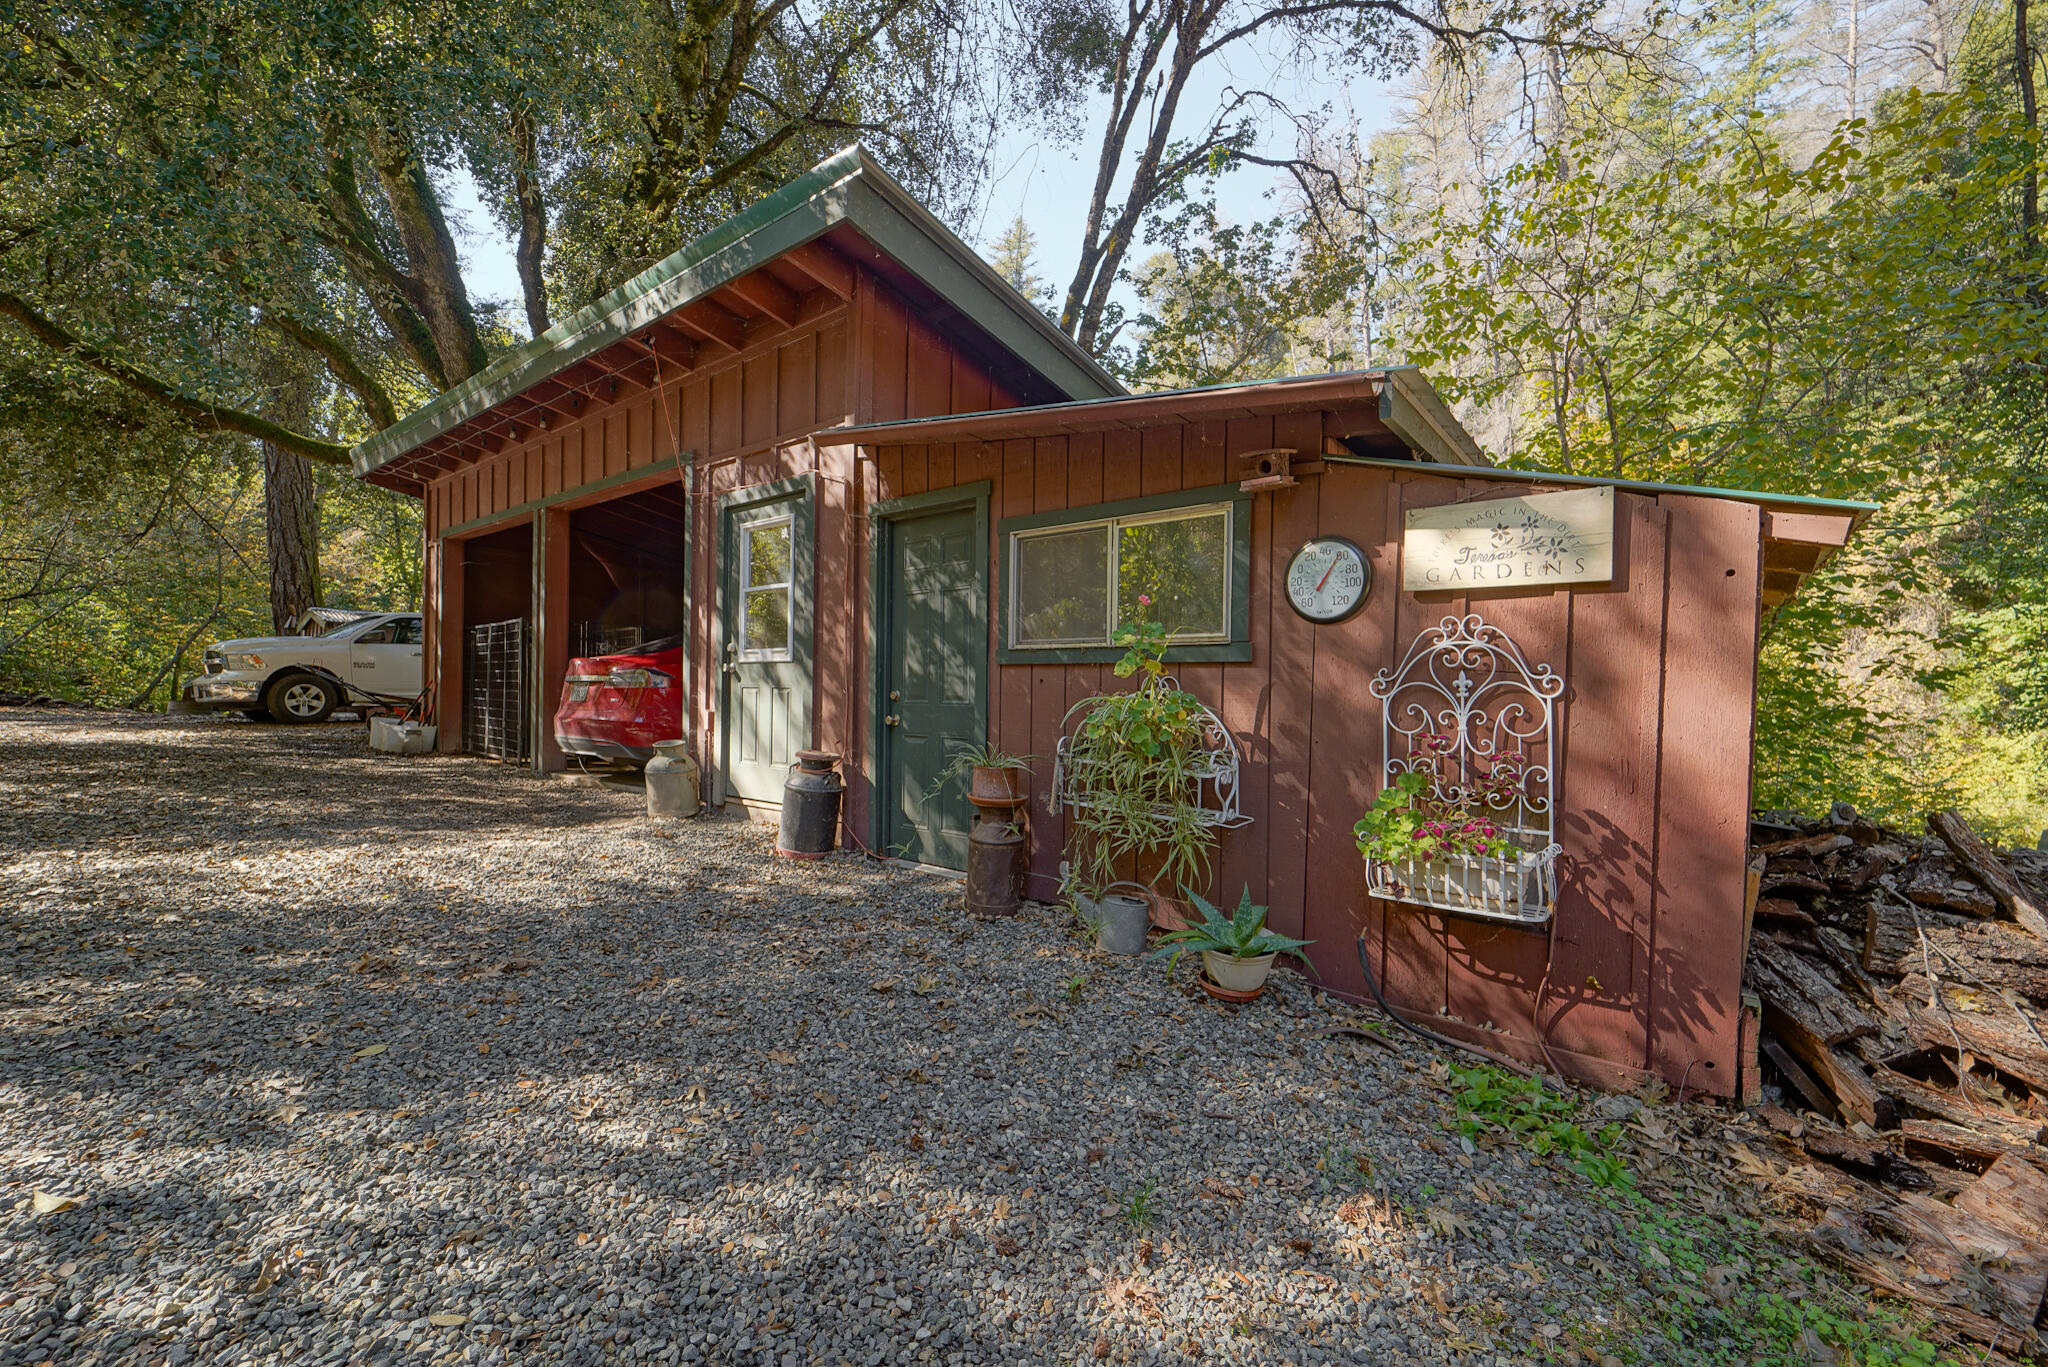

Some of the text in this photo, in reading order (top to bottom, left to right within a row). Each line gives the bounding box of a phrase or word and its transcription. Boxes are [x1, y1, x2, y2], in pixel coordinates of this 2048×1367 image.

[1465, 507, 1505, 528] MAGIC
[1513, 506, 1527, 516] IN
[1532, 510, 1556, 525] THE
[1304, 551, 1317, 562] 20
[1319, 546, 1332, 556] 40
[1336, 550, 1349, 561] 60
[1453, 545, 1518, 566] Teresa's
[1297, 564, 1304, 574] 0
[1345, 563, 1358, 574] 80
[1425, 557, 1586, 584] GARDENS
[1290, 576, 1303, 587] 20
[1344, 576, 1362, 588] 100
[1292, 586, 1305, 597] 40
[1300, 597, 1313, 608] 60
[1331, 594, 1350, 606] 120
